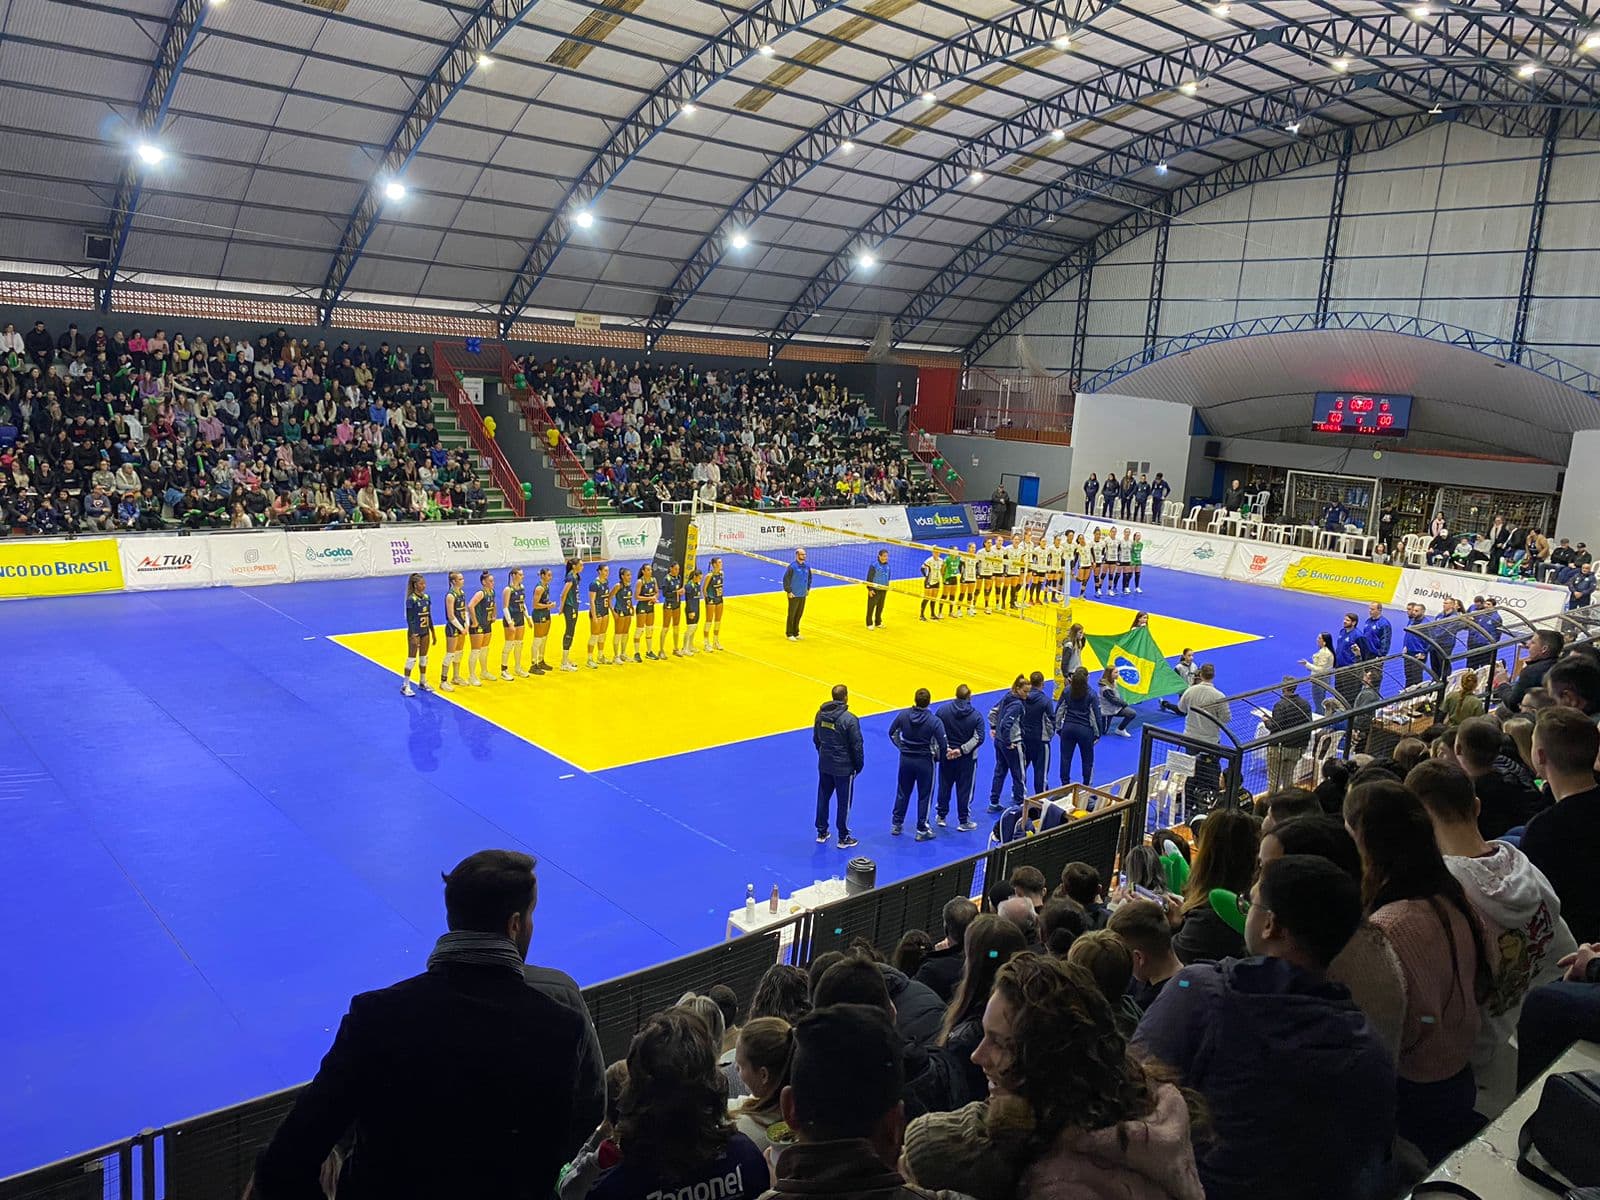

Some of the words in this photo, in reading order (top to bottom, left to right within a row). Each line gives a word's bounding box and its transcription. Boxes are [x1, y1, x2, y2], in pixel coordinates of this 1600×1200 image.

[760, 525, 786, 534] BATER
[390, 540, 409, 549] my
[446, 540, 482, 549] TAMANHO
[511, 536, 551, 549] Zagonel
[391, 548, 413, 557] pur
[163, 554, 192, 566] TUR
[393, 555, 411, 565] ple
[30, 564, 52, 577] DO
[54, 561, 112, 576] BRASIL
[1310, 569, 1340, 582] BANCO
[1341, 575, 1354, 584] DO
[1354, 576, 1385, 589] BRASIL
